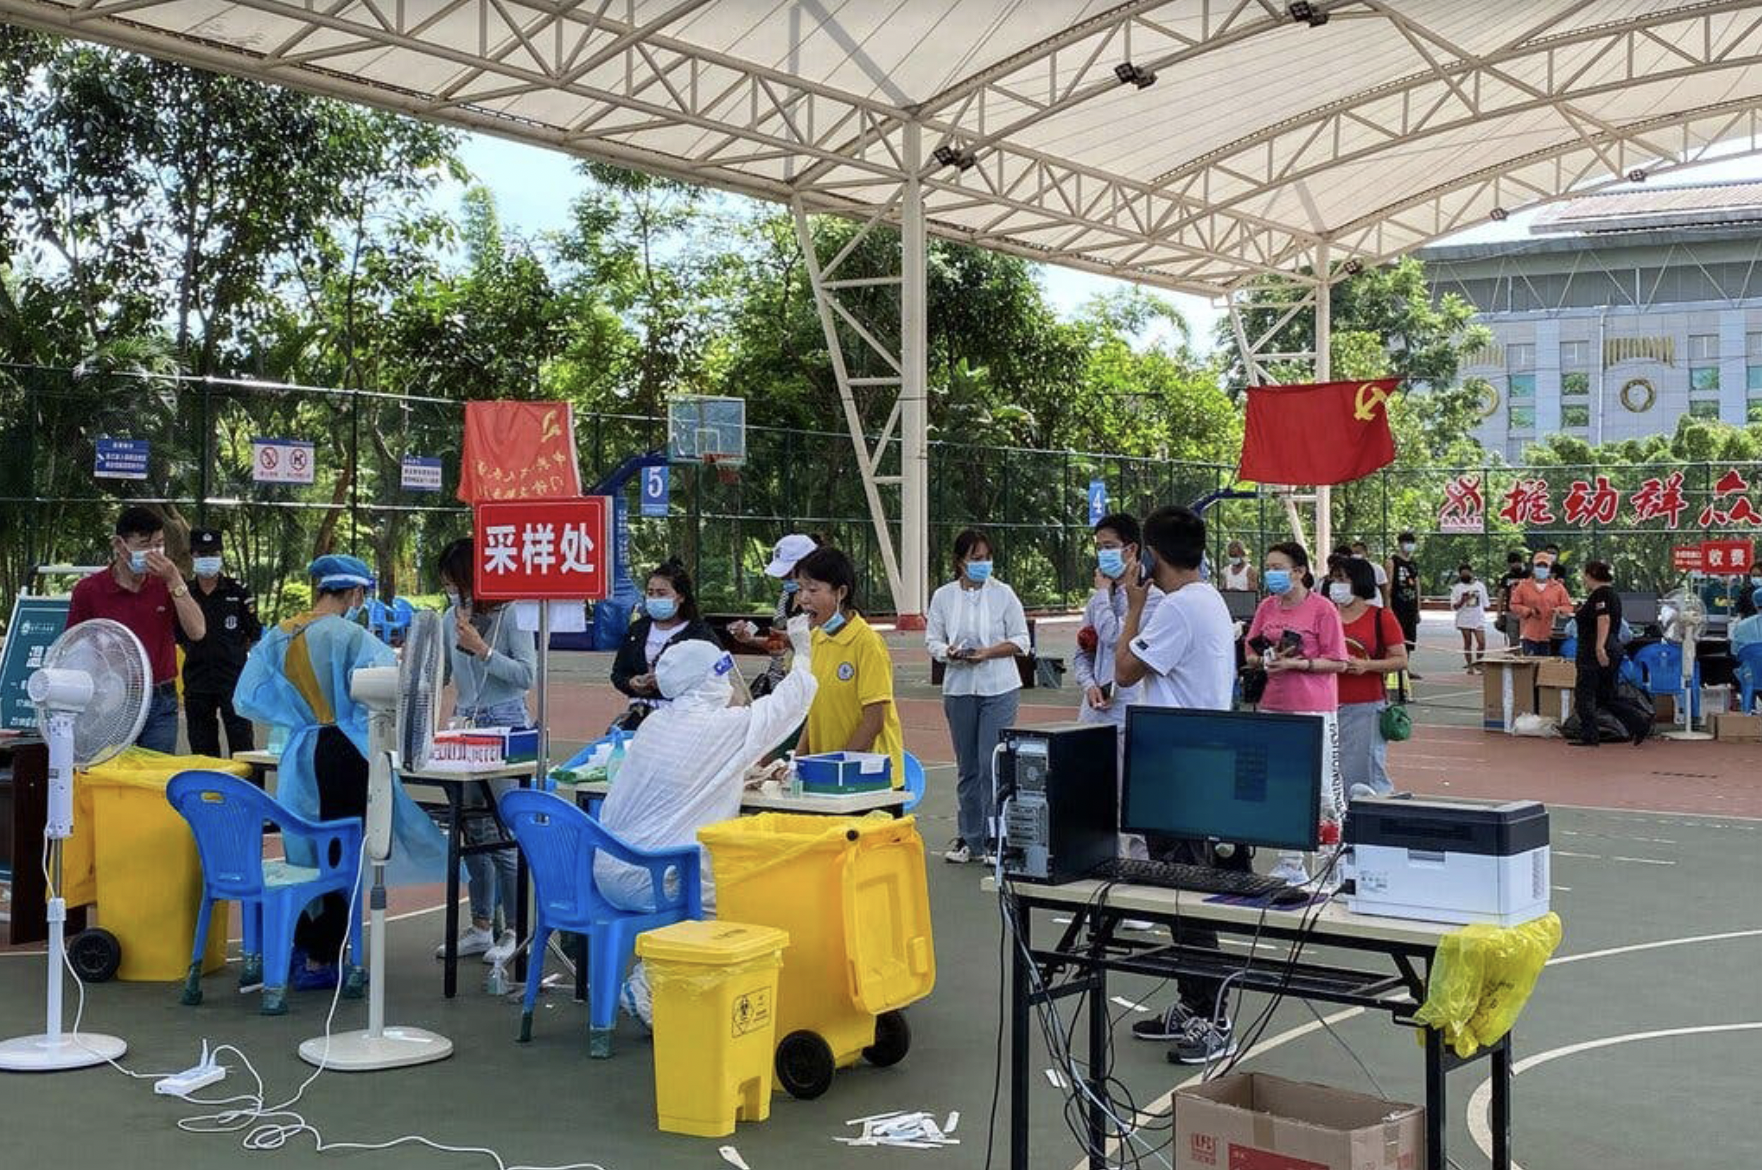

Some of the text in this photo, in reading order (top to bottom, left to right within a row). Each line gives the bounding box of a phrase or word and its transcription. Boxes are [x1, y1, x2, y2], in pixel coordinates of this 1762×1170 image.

[648, 466, 663, 498] 5
[1092, 489, 1103, 514] 4
[484, 522, 595, 575] 采样处
[1708, 548, 1746, 568] 收费
